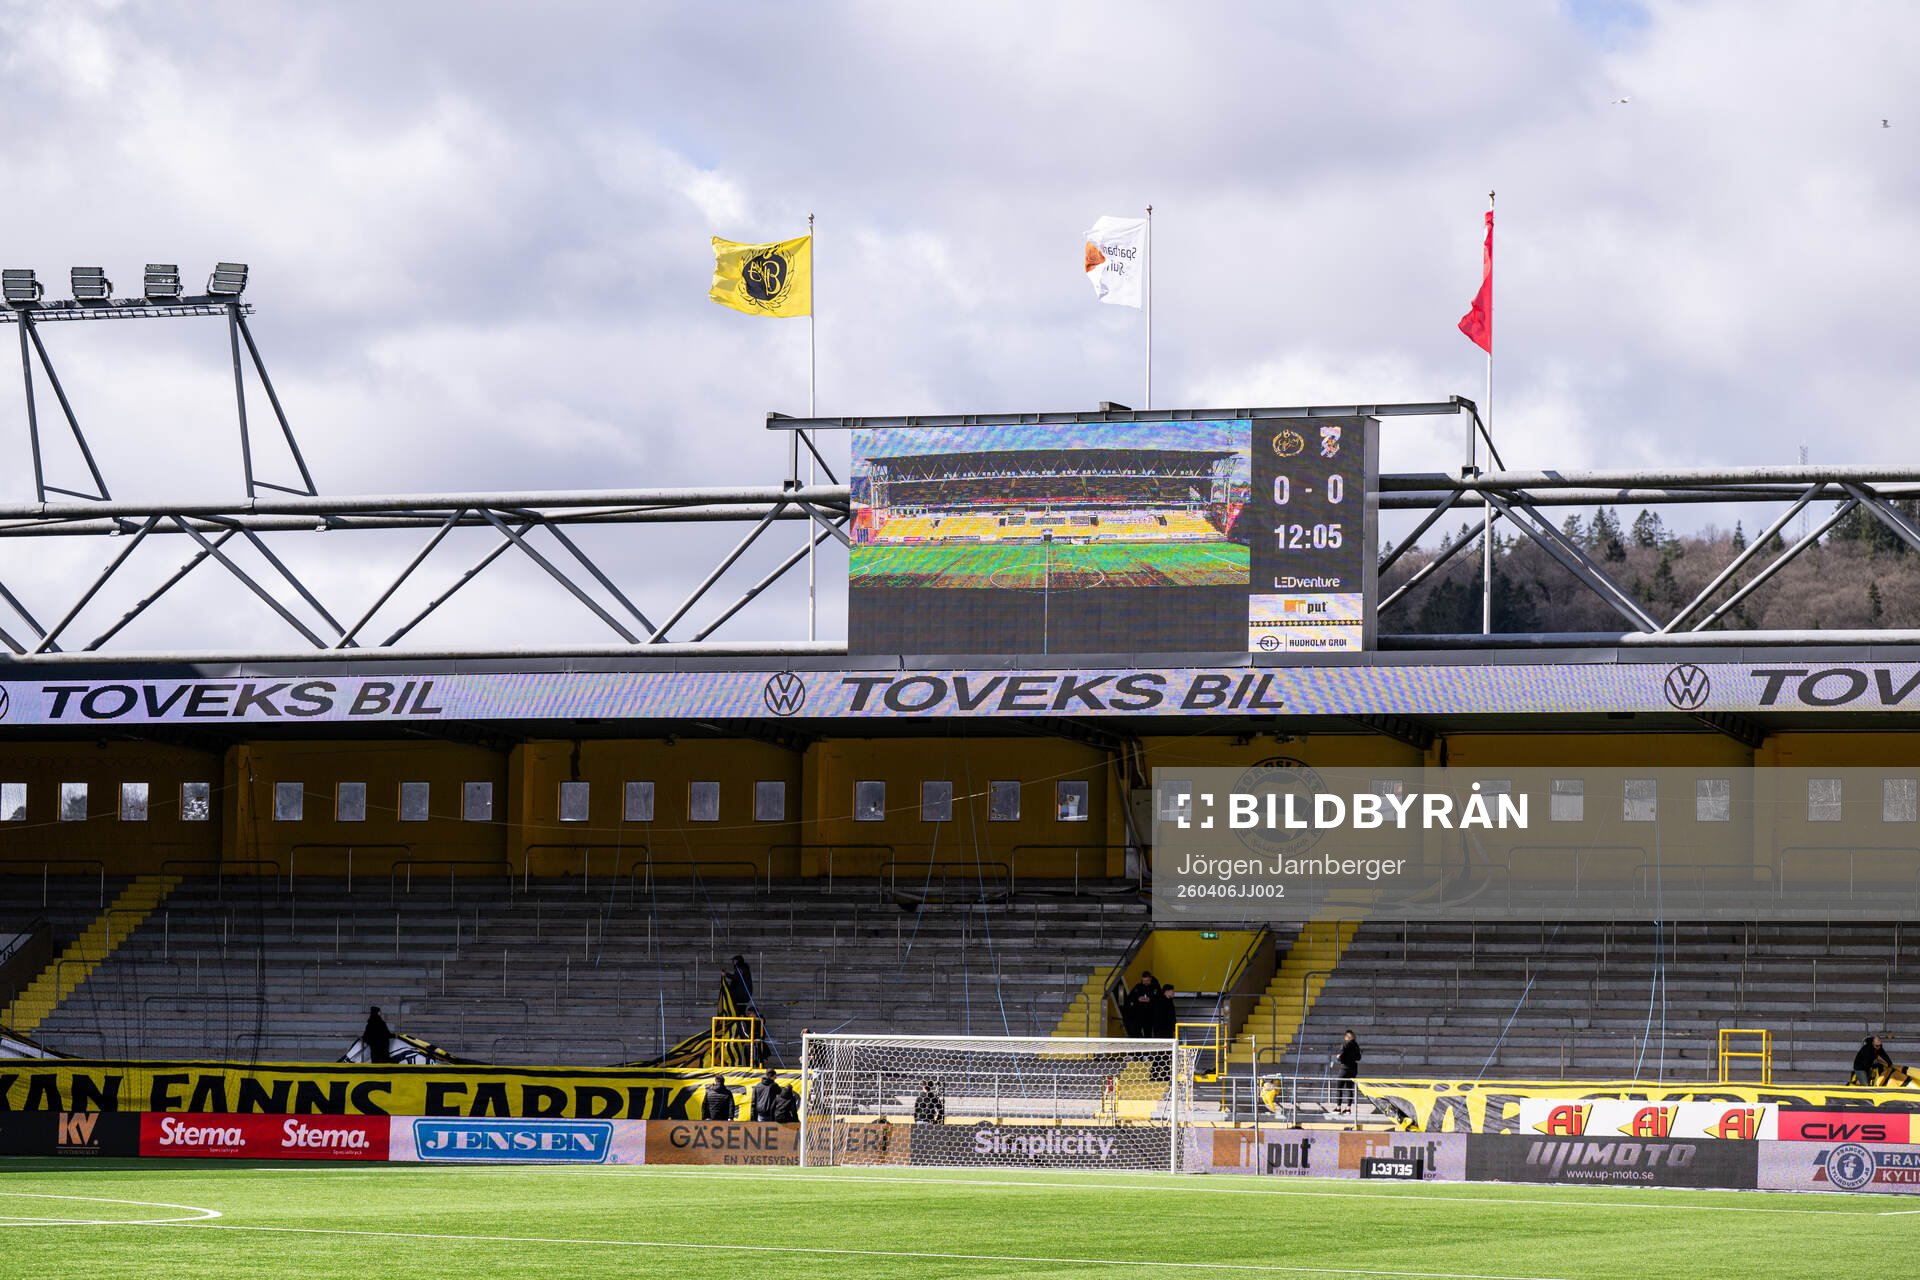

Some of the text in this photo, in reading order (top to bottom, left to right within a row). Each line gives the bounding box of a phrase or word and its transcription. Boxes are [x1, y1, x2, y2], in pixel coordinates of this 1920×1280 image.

[1274, 475, 1290, 505] 0
[1328, 474, 1344, 504] 0
[1274, 524, 1343, 549] 12:05
[1274, 576, 1340, 588] LEDventure
[41, 681, 336, 719] TOVEKS
[349, 681, 443, 716] BIL
[841, 673, 1285, 712] TOVEKS BIL
[426, 1131, 600, 1151] JENSEN
[670, 1124, 779, 1150] GÄSENE
[1800, 1123, 1886, 1141] CWS
[724, 1155, 738, 1165] EN
[1371, 1163, 1413, 1176] SELECT
[1566, 1169, 1655, 1181] www.up-moto.se
[1882, 1170, 1920, 1182] KYLI
